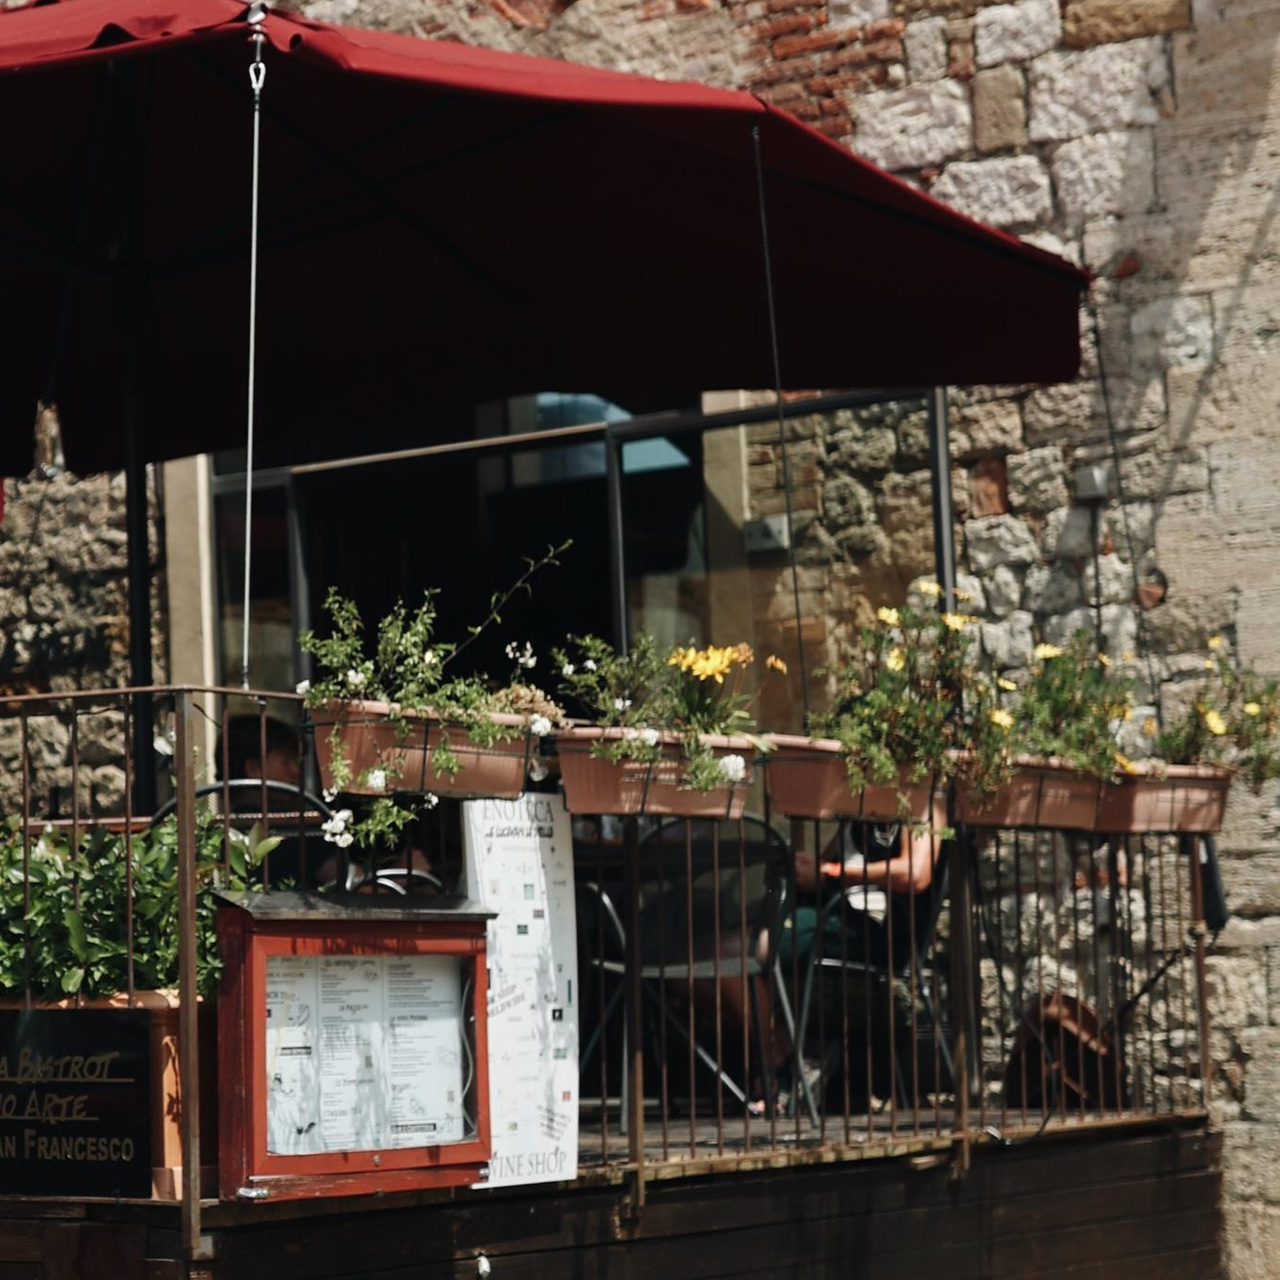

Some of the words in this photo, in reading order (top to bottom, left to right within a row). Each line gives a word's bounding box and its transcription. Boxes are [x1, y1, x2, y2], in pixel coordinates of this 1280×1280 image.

[19, 1046, 120, 1083] BISTROT
[25, 1090, 89, 1120] ARTE
[23, 1128, 134, 1162] FRANCESCO
[527, 1150, 567, 1176] SHOP
